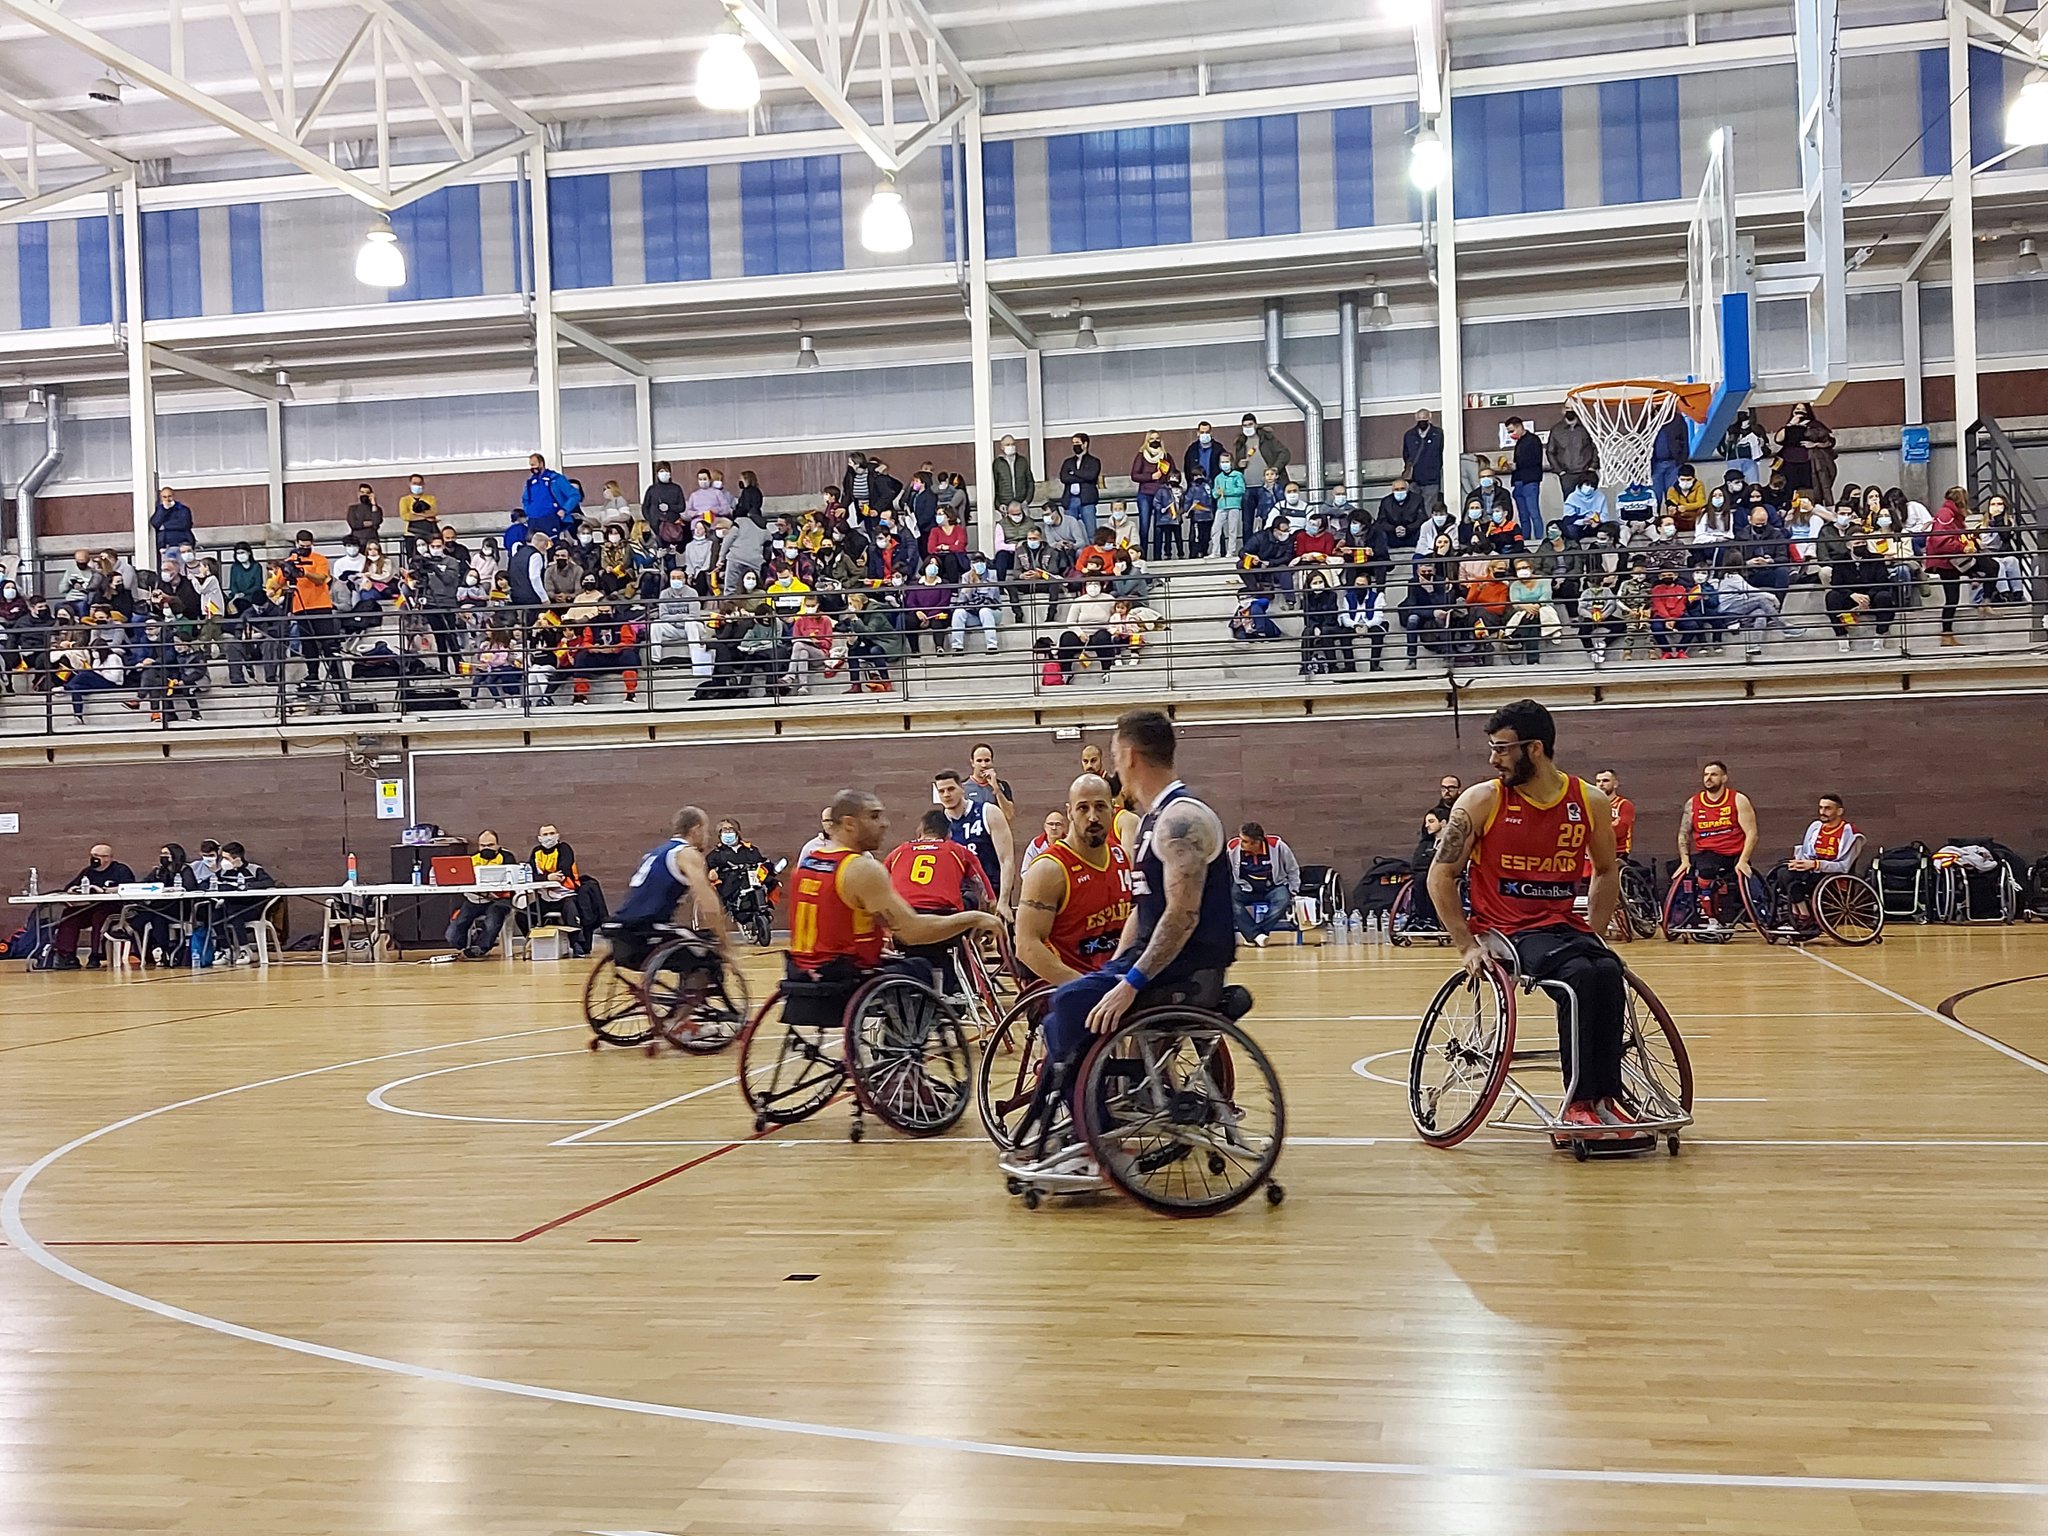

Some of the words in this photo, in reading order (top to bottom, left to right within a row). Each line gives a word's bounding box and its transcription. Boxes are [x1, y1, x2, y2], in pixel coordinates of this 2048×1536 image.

[962, 819, 983, 840] 14
[1557, 823, 1586, 848] 28
[910, 854, 936, 885] 6
[1501, 850, 1577, 872] ESPAÑA
[1521, 883, 1573, 898] CaixaBank
